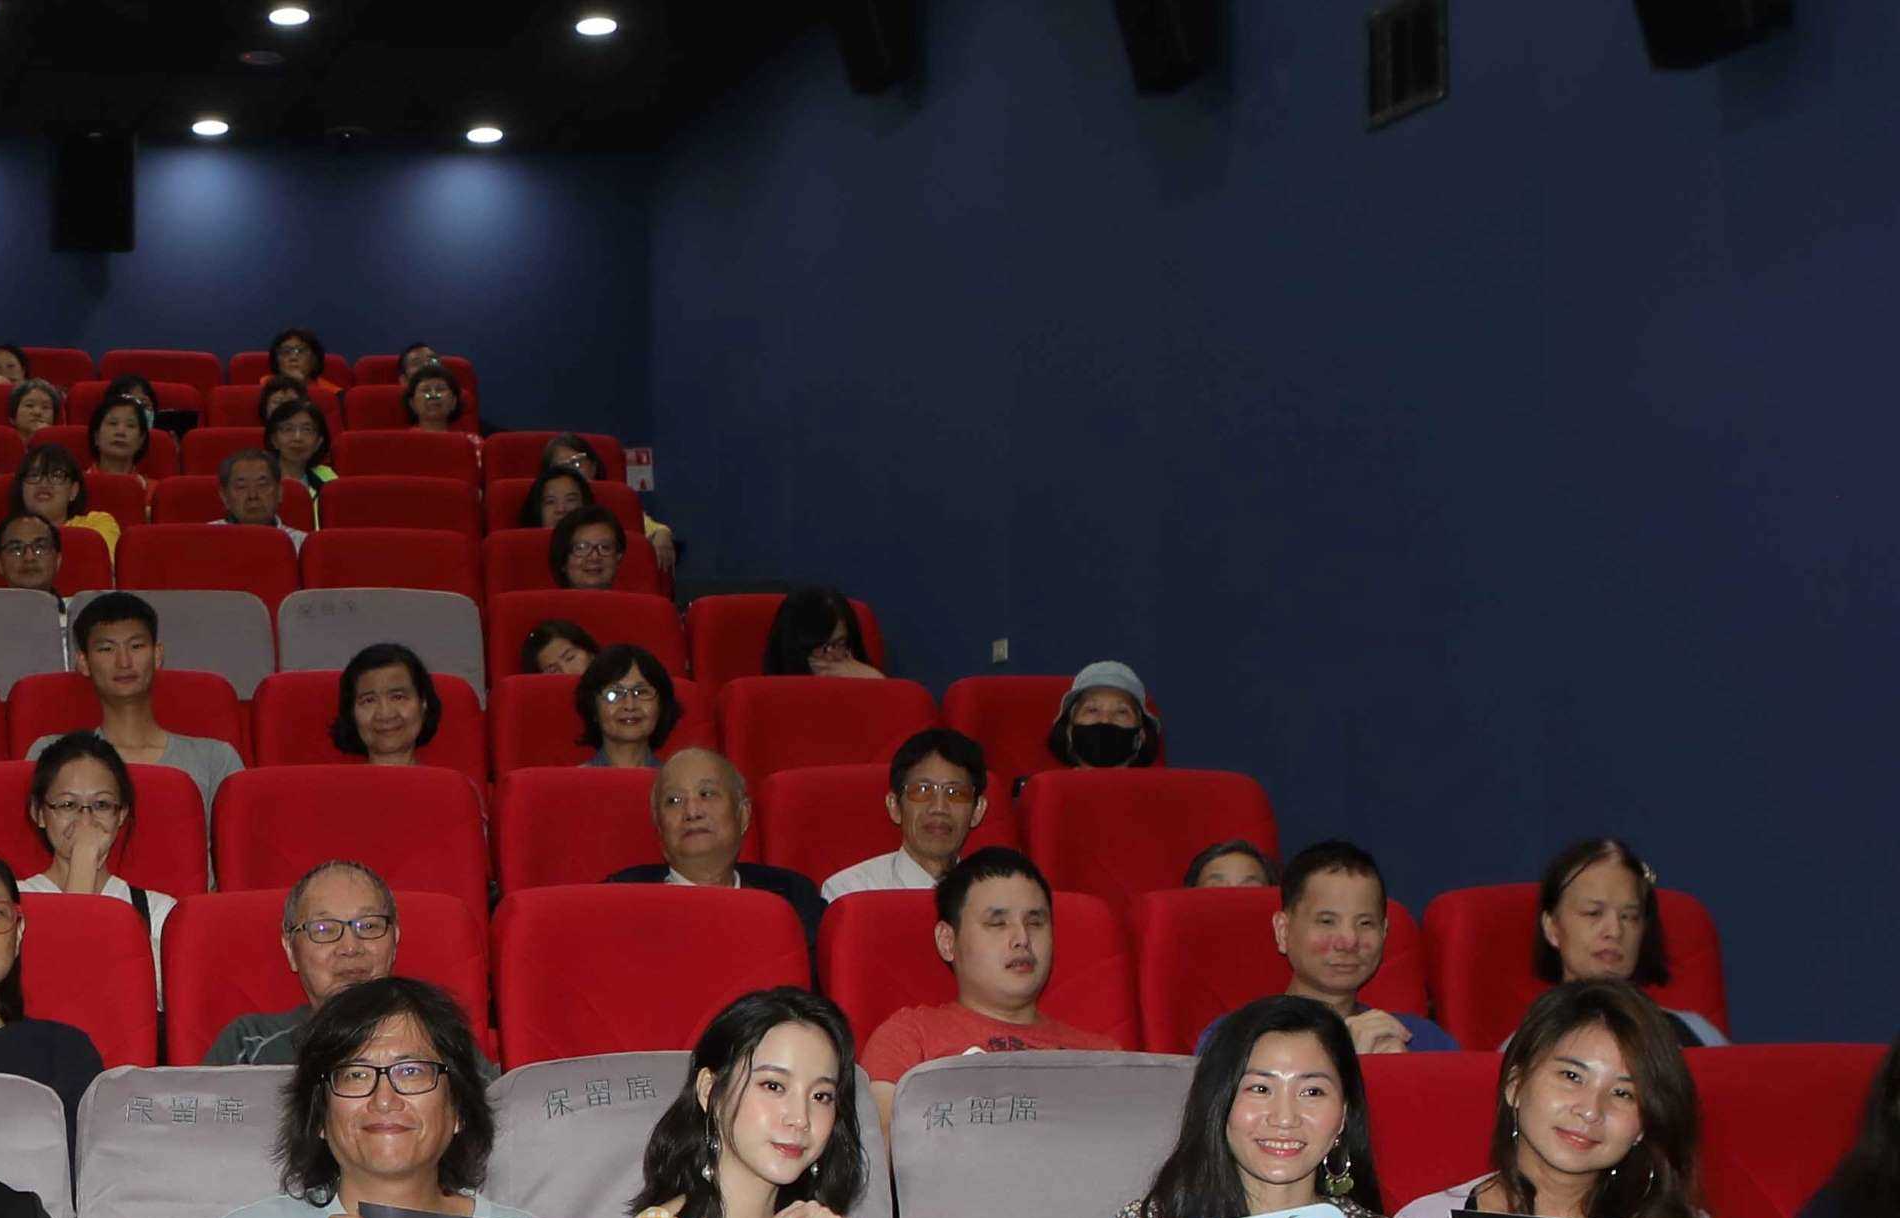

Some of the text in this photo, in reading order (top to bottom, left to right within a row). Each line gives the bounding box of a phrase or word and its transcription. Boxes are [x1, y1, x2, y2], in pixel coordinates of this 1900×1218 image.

[124, 1094, 245, 1124] 保留席
[541, 1074, 658, 1120] 保留席
[922, 1094, 1038, 1130] 保留席
